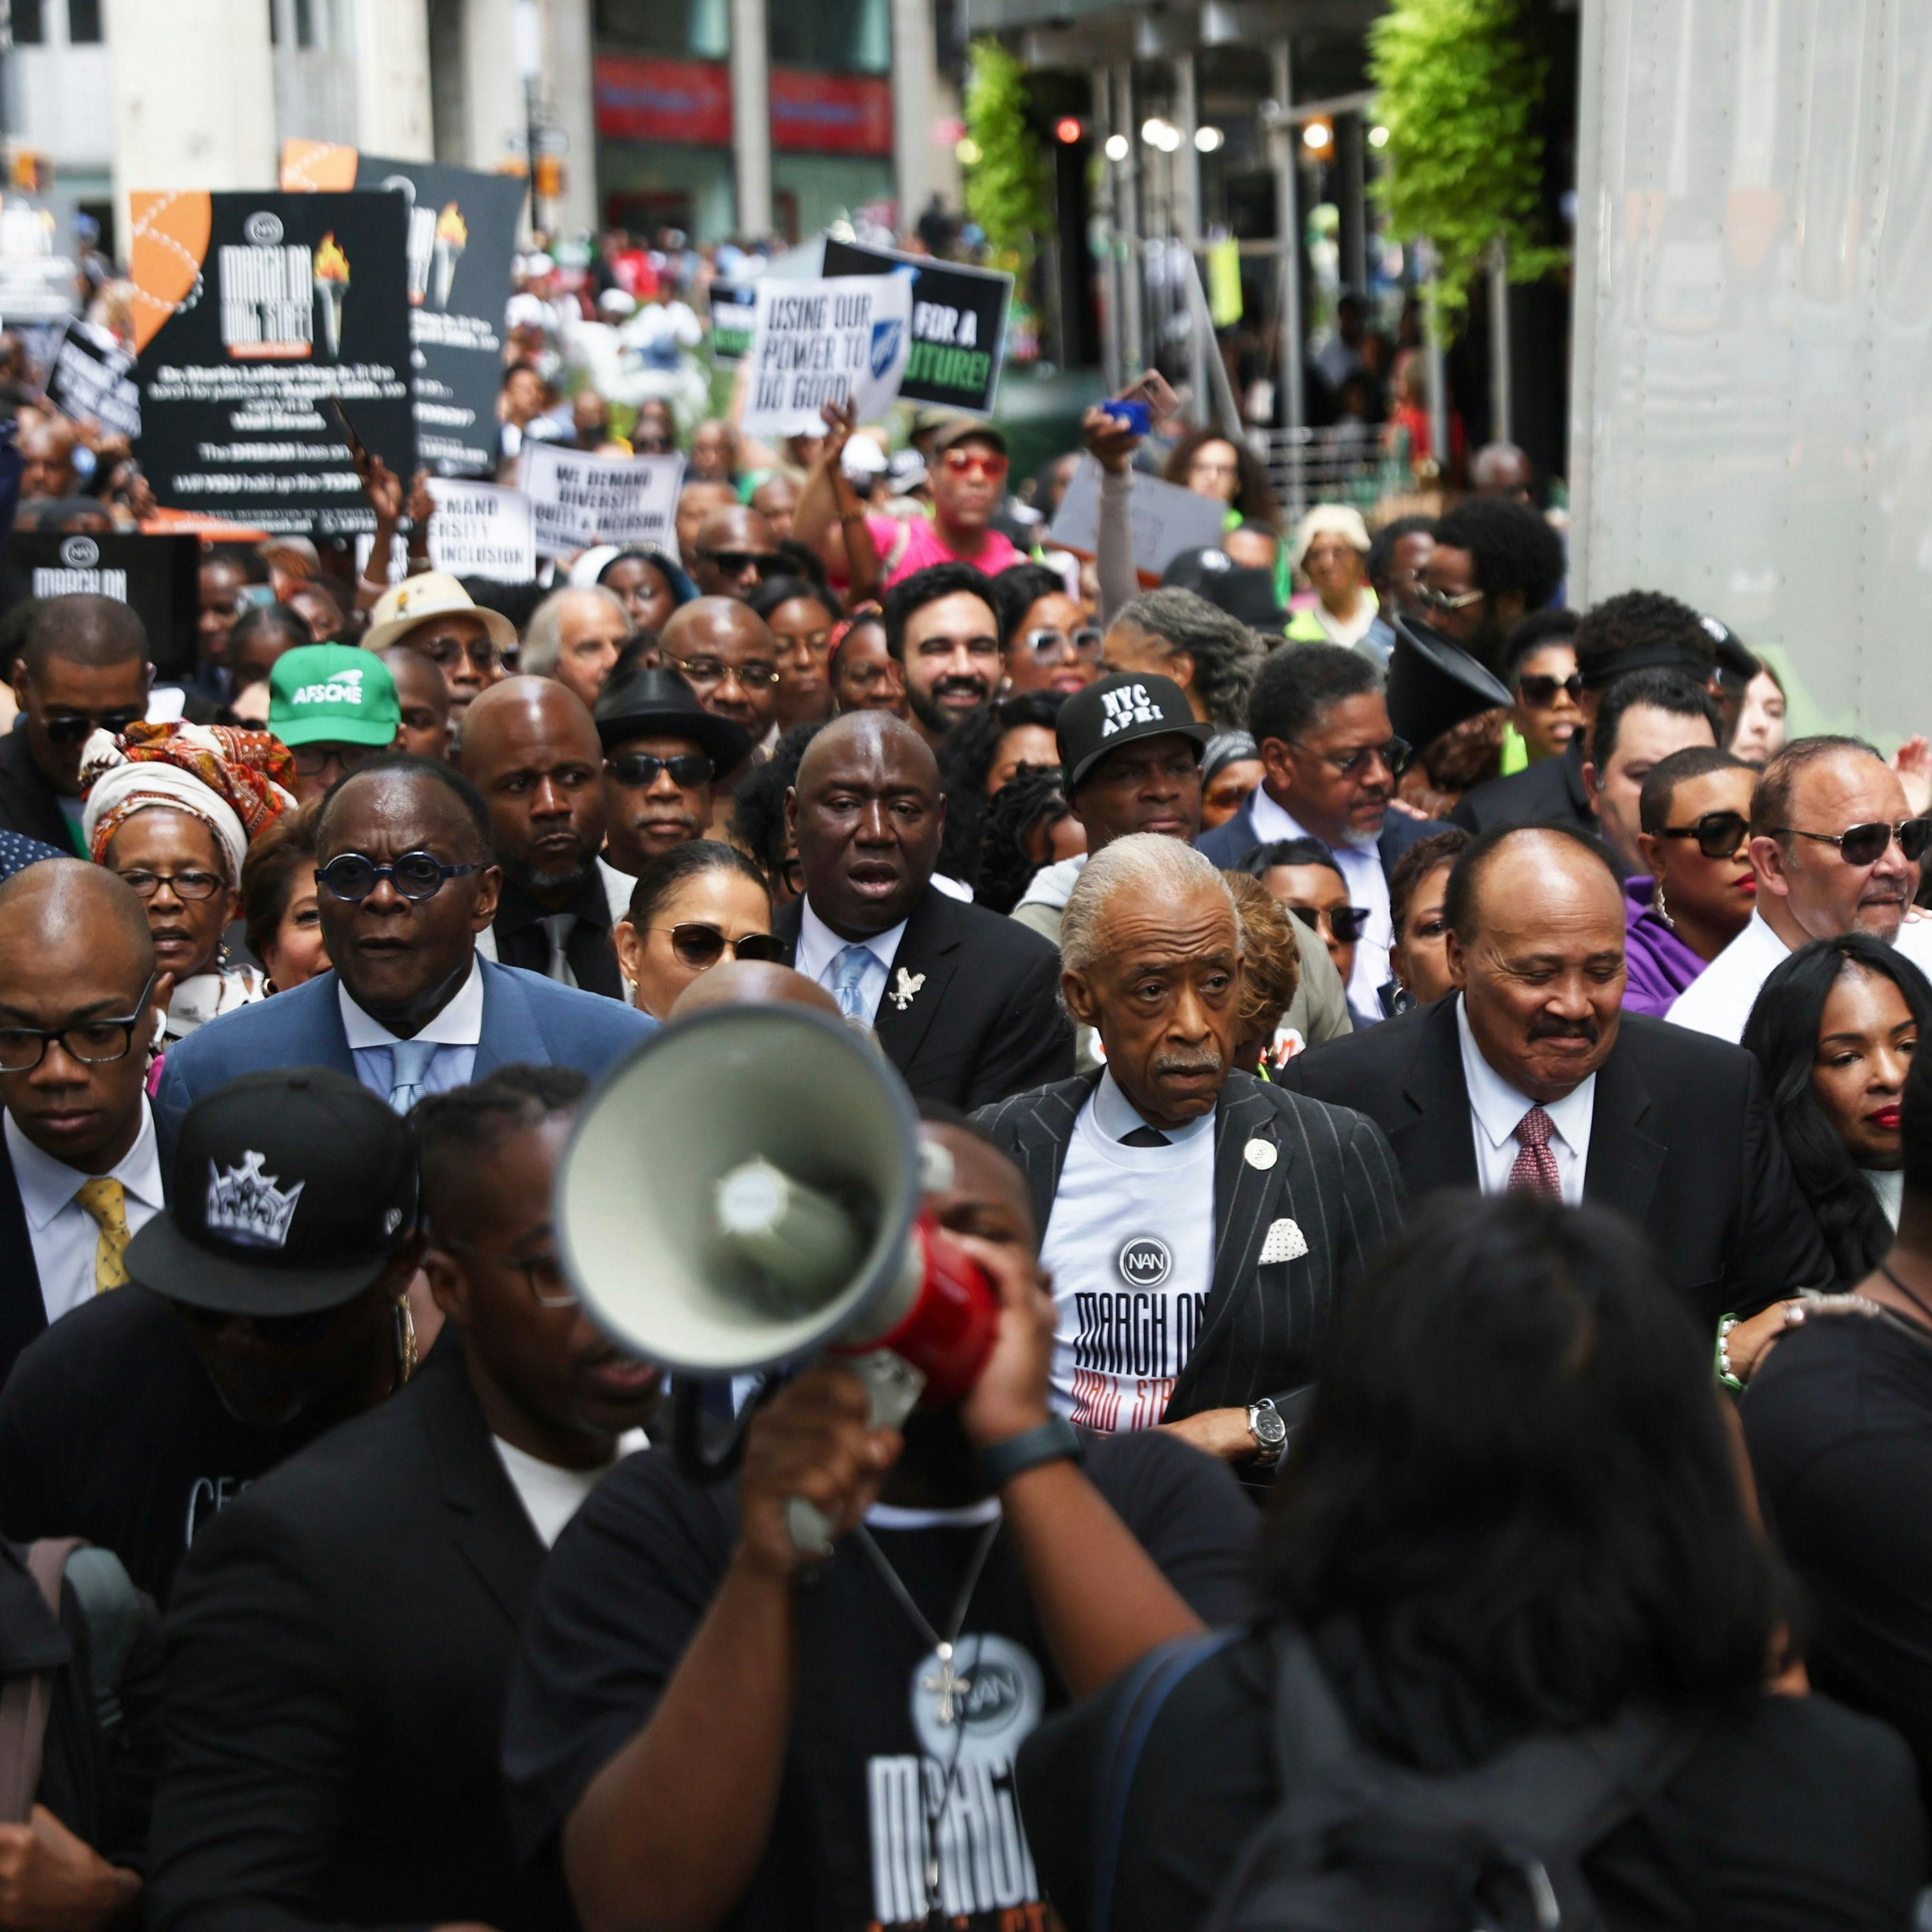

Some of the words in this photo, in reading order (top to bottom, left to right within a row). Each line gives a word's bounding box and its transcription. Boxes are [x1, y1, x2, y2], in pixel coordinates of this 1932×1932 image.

[769, 295, 828, 330] USING
[835, 293, 872, 328] OUR
[914, 301, 958, 343] FOR
[956, 309, 978, 348] A
[763, 336, 835, 371] POWER
[845, 333, 865, 369] TO
[756, 376, 784, 410] DO
[440, 546, 522, 564] INCLUSION
[1101, 683, 1151, 718] NYC
[1101, 704, 1164, 739] APRI
[1128, 1252, 1165, 1270] NAN
[1072, 1292, 1168, 1378] MARCH
[1069, 1367, 1123, 1433] WALL
[1130, 1377, 1180, 1434] STR
